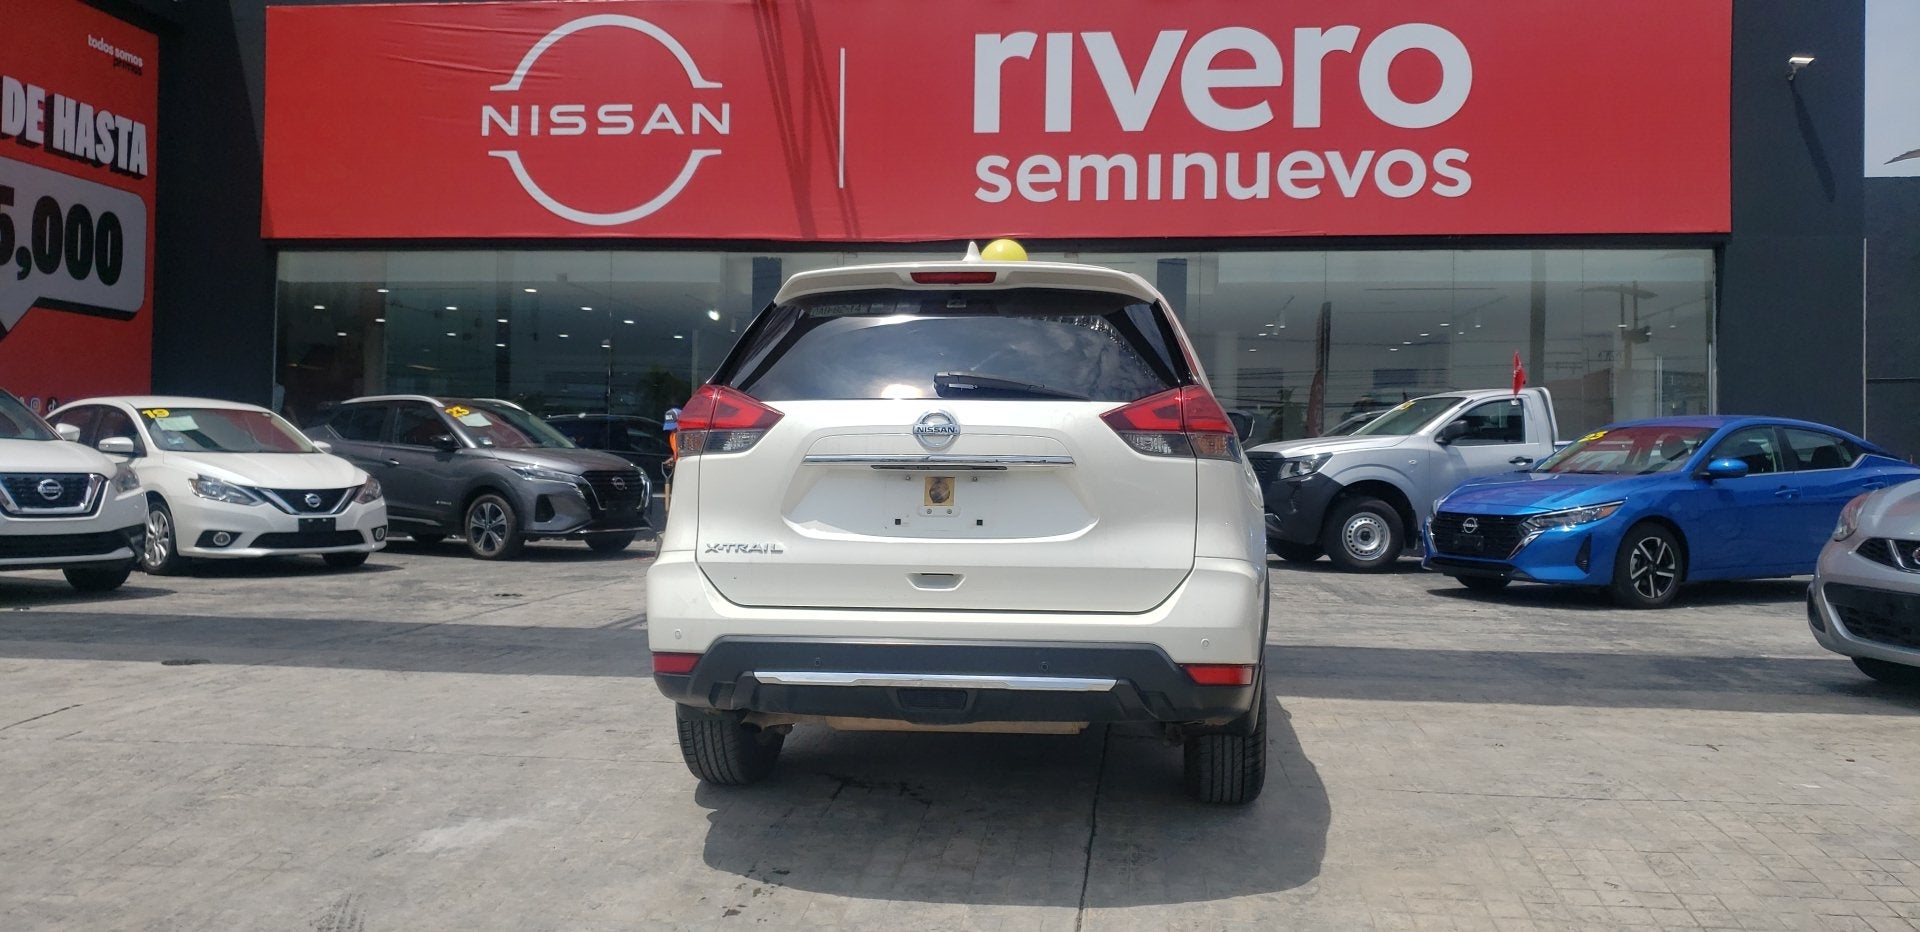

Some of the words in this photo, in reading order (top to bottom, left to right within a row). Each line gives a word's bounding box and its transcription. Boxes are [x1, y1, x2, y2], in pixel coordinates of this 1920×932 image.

[88, 34, 114, 56] todos
[115, 48, 143, 67] somos
[973, 22, 1473, 133] rivero
[1, 75, 46, 145] DE
[52, 92, 148, 177] HASTA
[481, 102, 730, 137] NISSAN
[974, 147, 1473, 203] seminuevos
[704, 542, 784, 555] X-TRAIL
